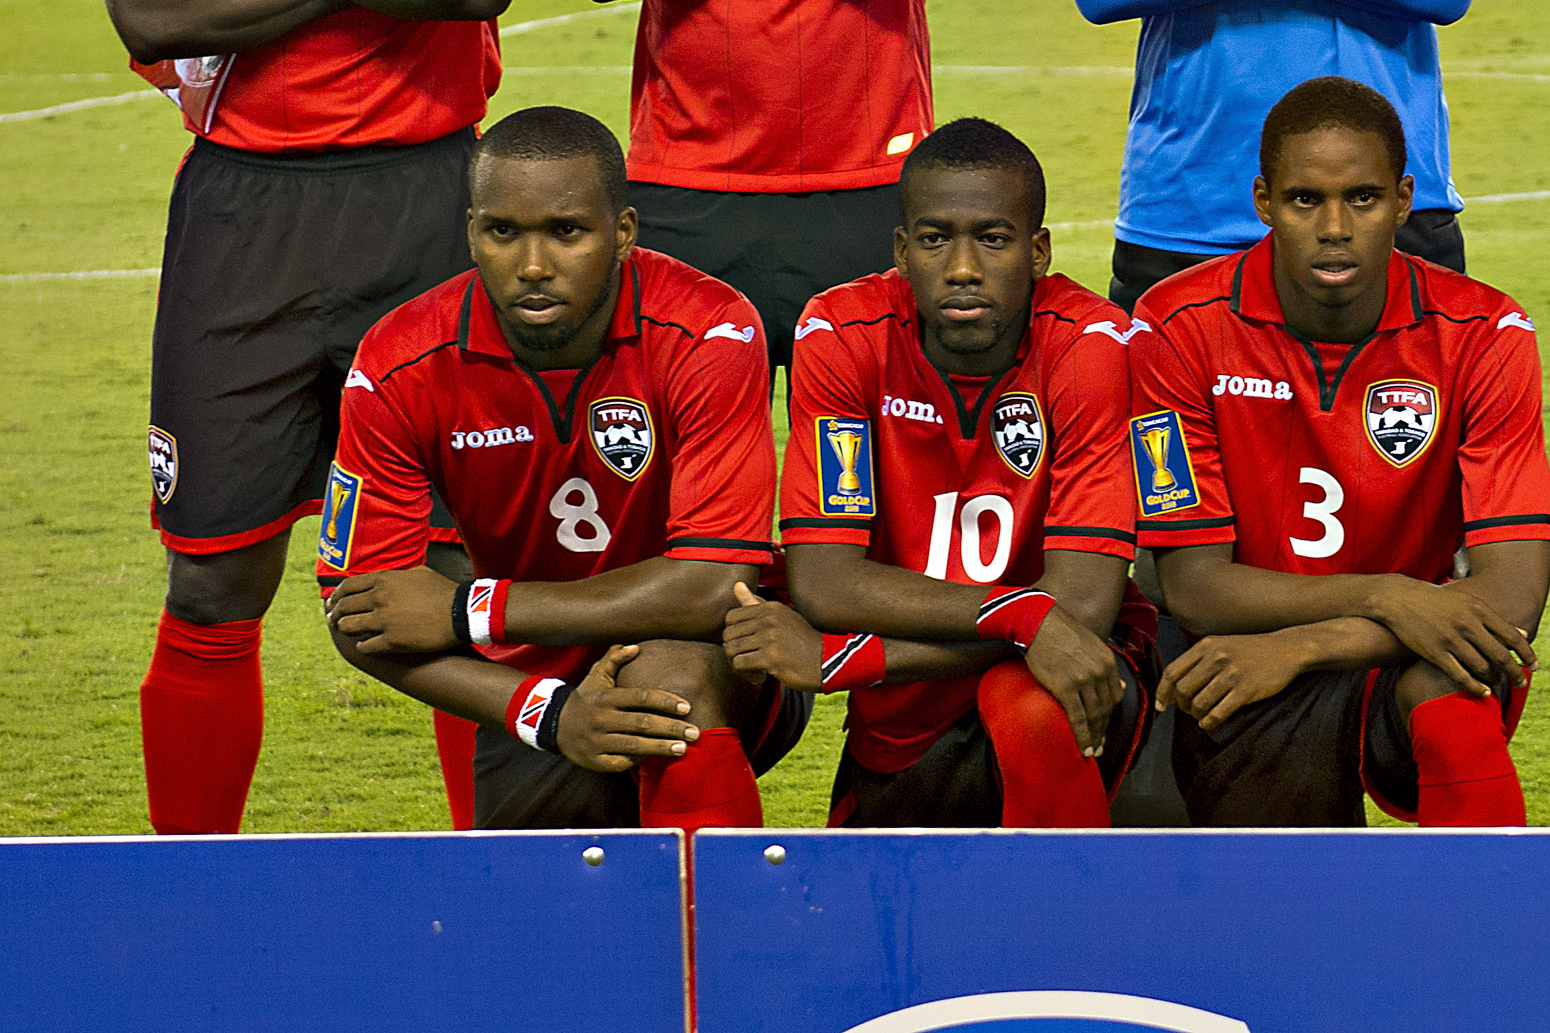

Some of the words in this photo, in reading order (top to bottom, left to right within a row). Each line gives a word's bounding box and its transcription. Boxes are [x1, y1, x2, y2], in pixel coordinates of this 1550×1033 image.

[1212, 374, 1293, 401] Joma
[1377, 391, 1427, 405] TTFA
[598, 408, 642, 422] TTFA
[996, 403, 1032, 420] TTFA
[451, 425, 534, 450] Joma
[549, 477, 612, 552] 8
[1289, 467, 1344, 559] 3
[924, 491, 1014, 583] 10
